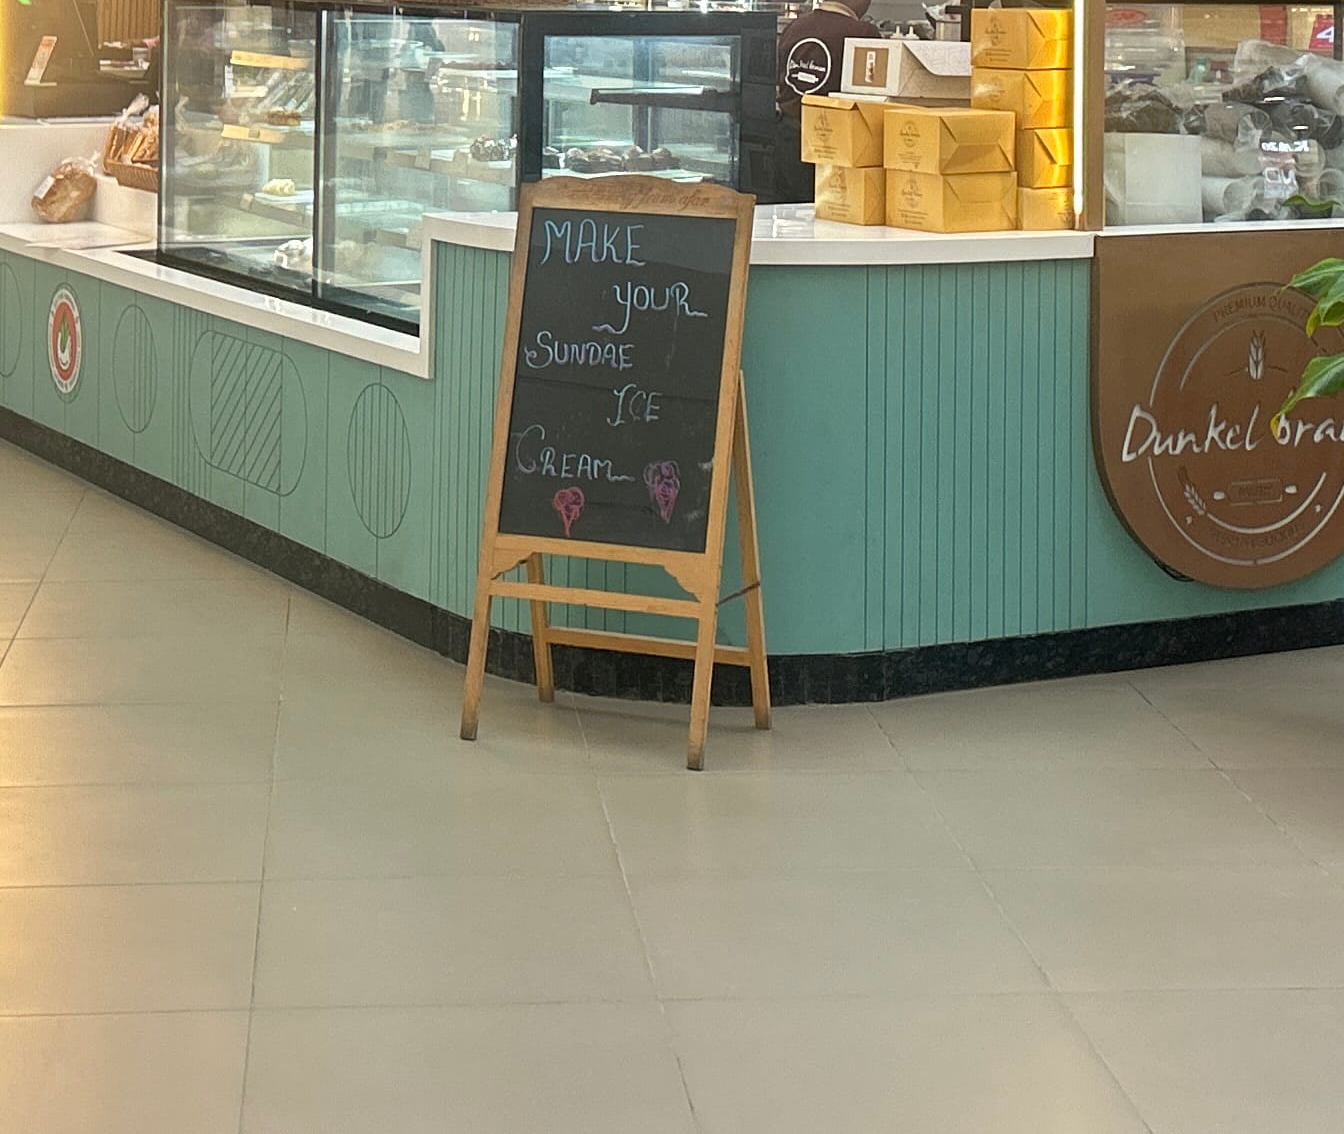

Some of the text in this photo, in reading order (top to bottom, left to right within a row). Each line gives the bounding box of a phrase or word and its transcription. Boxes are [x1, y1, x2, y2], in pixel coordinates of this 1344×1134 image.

[541, 218, 646, 267] MAKE
[592, 281, 708, 334] YOUR
[607, 383, 664, 426] ICE
[1122, 403, 1259, 462] Dunkel
